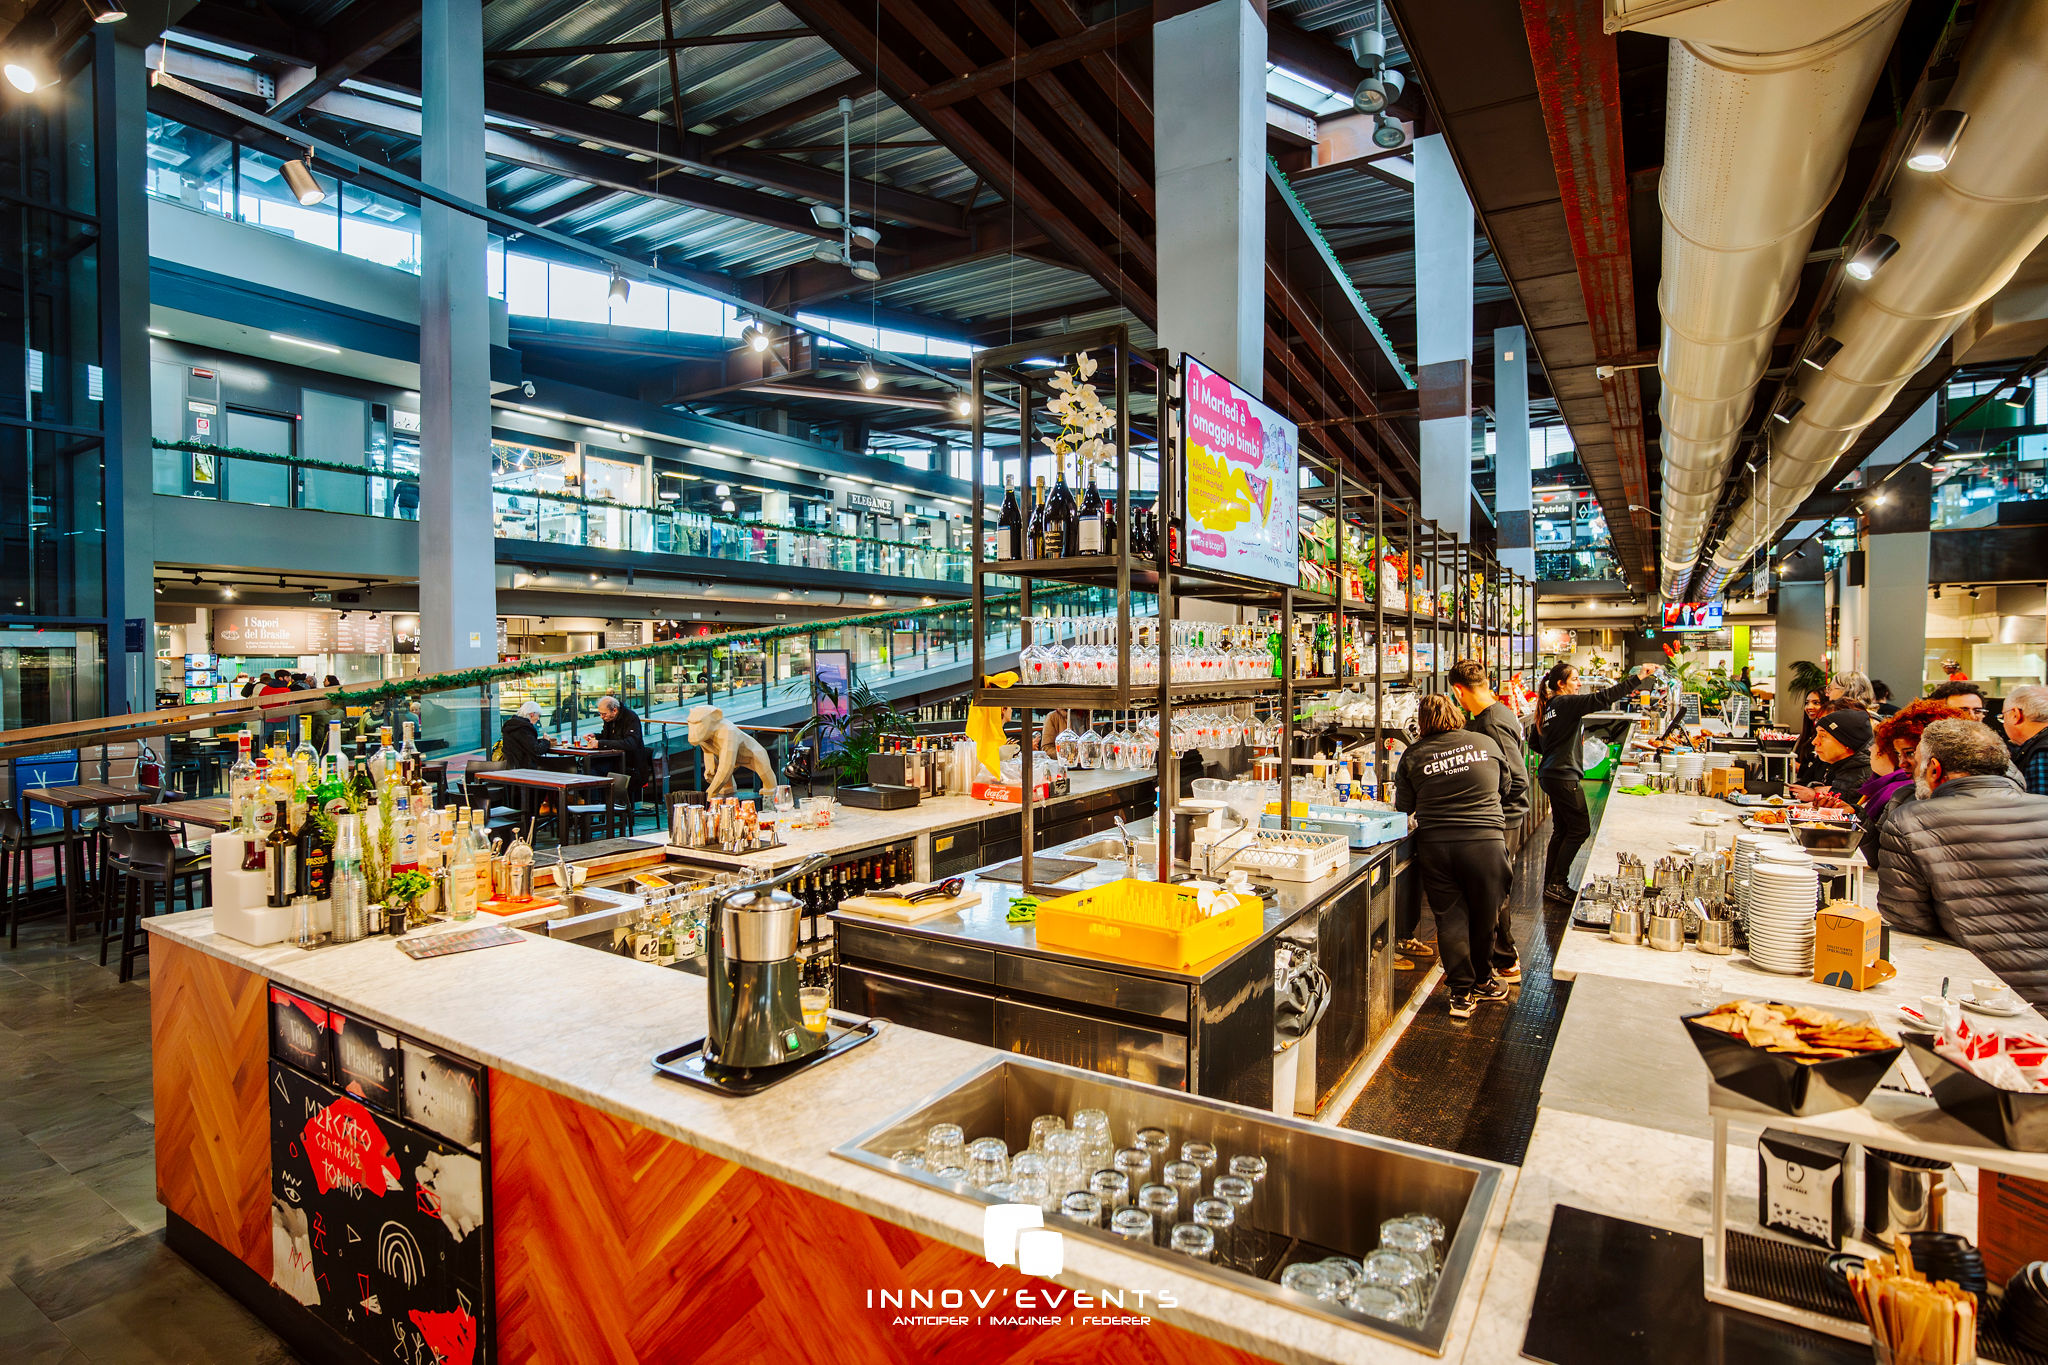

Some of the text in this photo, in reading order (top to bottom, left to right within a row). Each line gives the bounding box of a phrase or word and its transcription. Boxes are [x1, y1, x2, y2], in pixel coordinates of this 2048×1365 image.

[1192, 378, 1246, 427] il Martedì è
[1193, 414, 1260, 459] omaggio bimbi
[852, 494, 892, 510] ELEGANCE
[1540, 504, 1569, 514] Patrizia
[244, 628, 290, 640] del Brasile
[251, 616, 279, 629] Sapori
[1423, 750, 1489, 775] CENTRALE
[1432, 744, 1474, 760] il mercato
[1444, 765, 1470, 775] TORINO
[346, 1042, 385, 1083] Plastica
[305, 1096, 372, 1152] MERCATO
[315, 1131, 362, 1170] CENTRALE
[321, 1158, 363, 1200] TORINO
